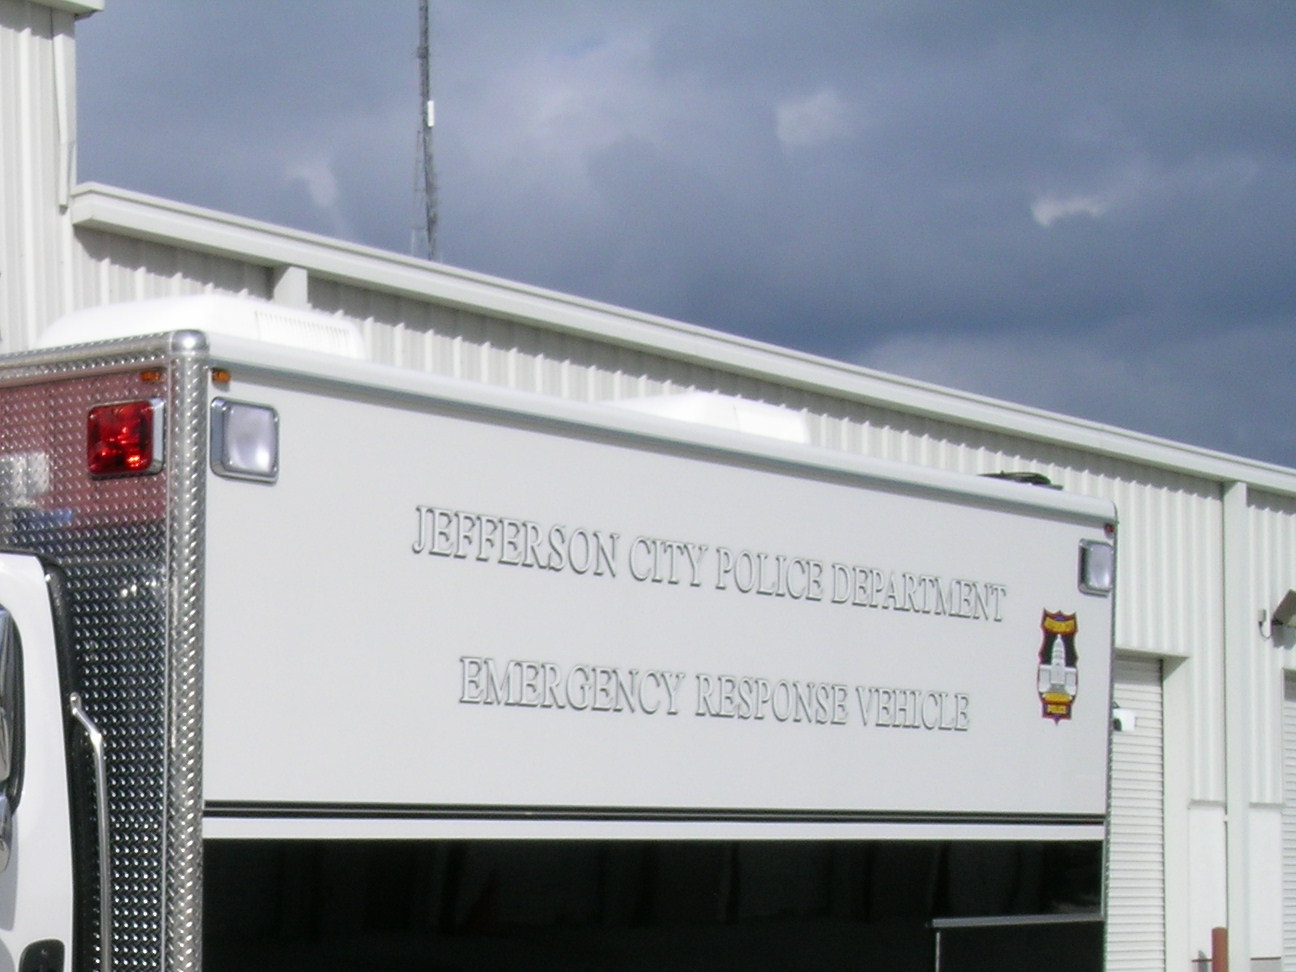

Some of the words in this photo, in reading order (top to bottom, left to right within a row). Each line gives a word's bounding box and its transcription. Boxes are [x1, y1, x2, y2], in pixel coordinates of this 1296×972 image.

[412, 504, 620, 578] JEFFERSON
[628, 534, 709, 588] CITY
[715, 546, 823, 603] POLICE
[831, 562, 1007, 623] DEPARTMENT
[459, 655, 686, 716] EMERGENCY
[694, 672, 848, 727] RESPONSE
[855, 684, 970, 733] VEHICLE
